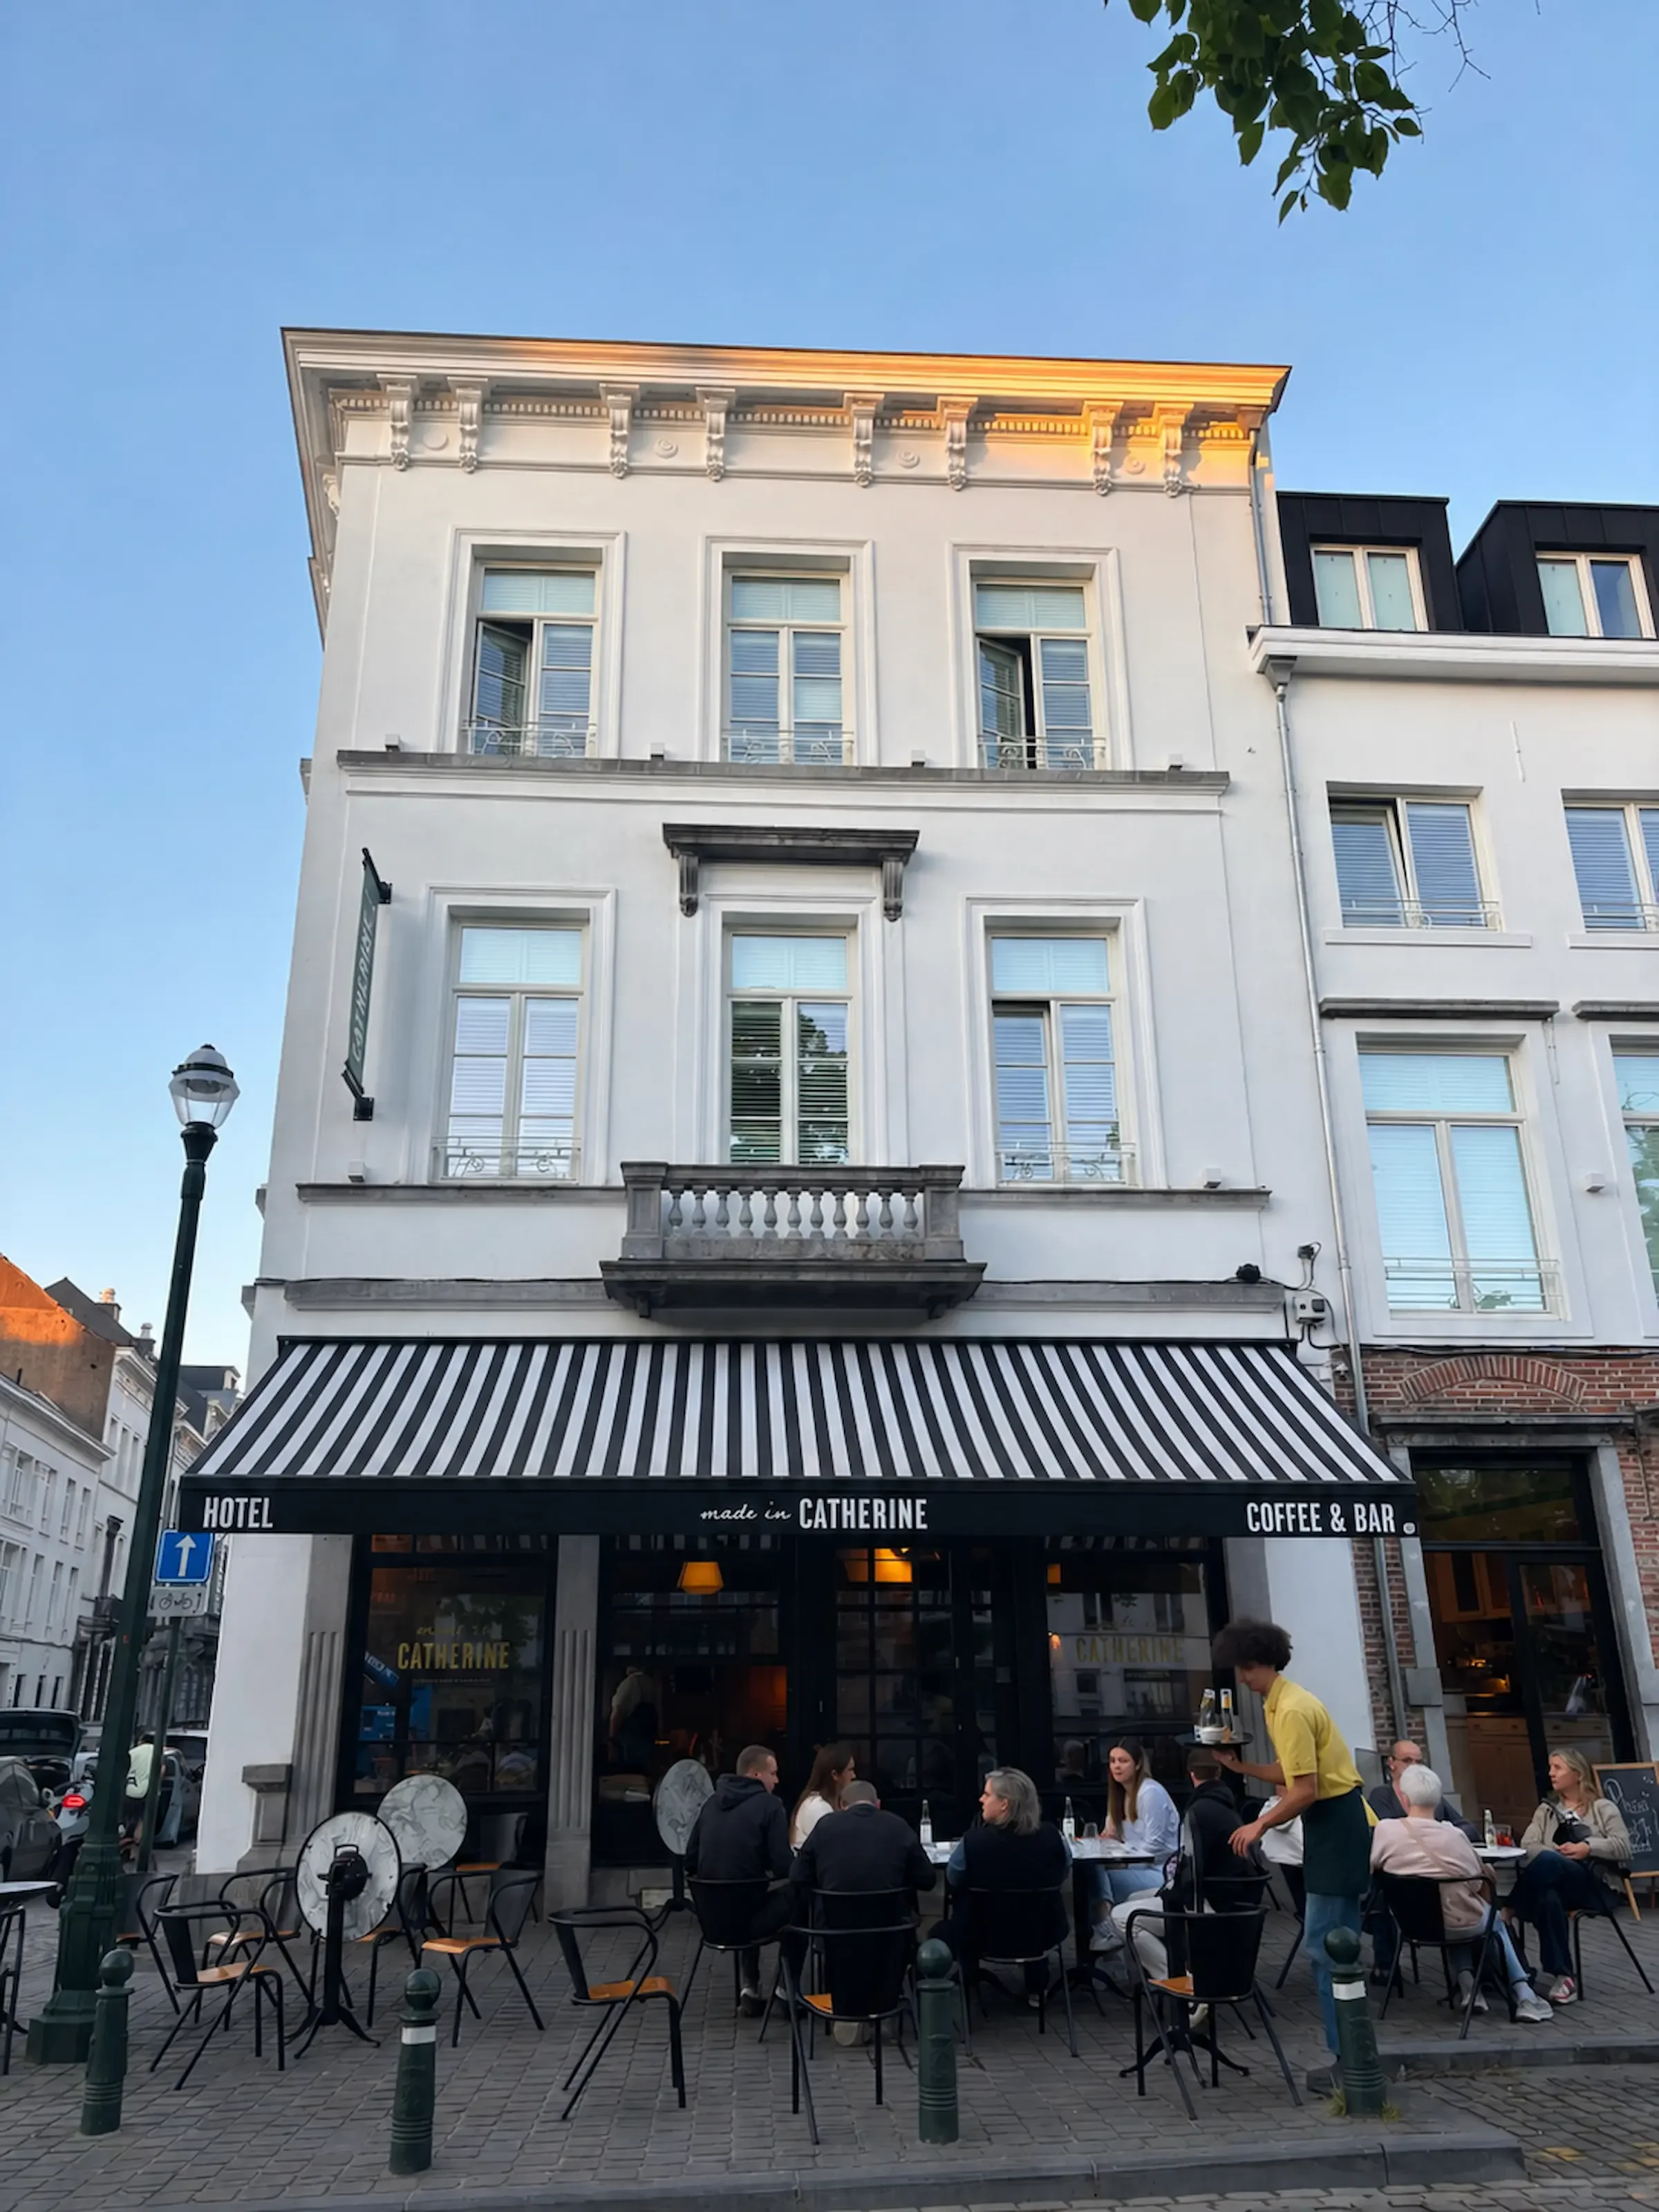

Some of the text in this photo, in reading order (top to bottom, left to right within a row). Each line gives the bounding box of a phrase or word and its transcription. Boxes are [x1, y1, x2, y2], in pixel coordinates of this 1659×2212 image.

[203, 1497, 273, 1528] HOTEL
[700, 1498, 928, 1529] made in CATHERINE
[1246, 1502, 1396, 1533] COFFEE & BAR
[397, 1642, 509, 1669] CATHERINE
[1076, 1636, 1185, 1662] CATHERINE
